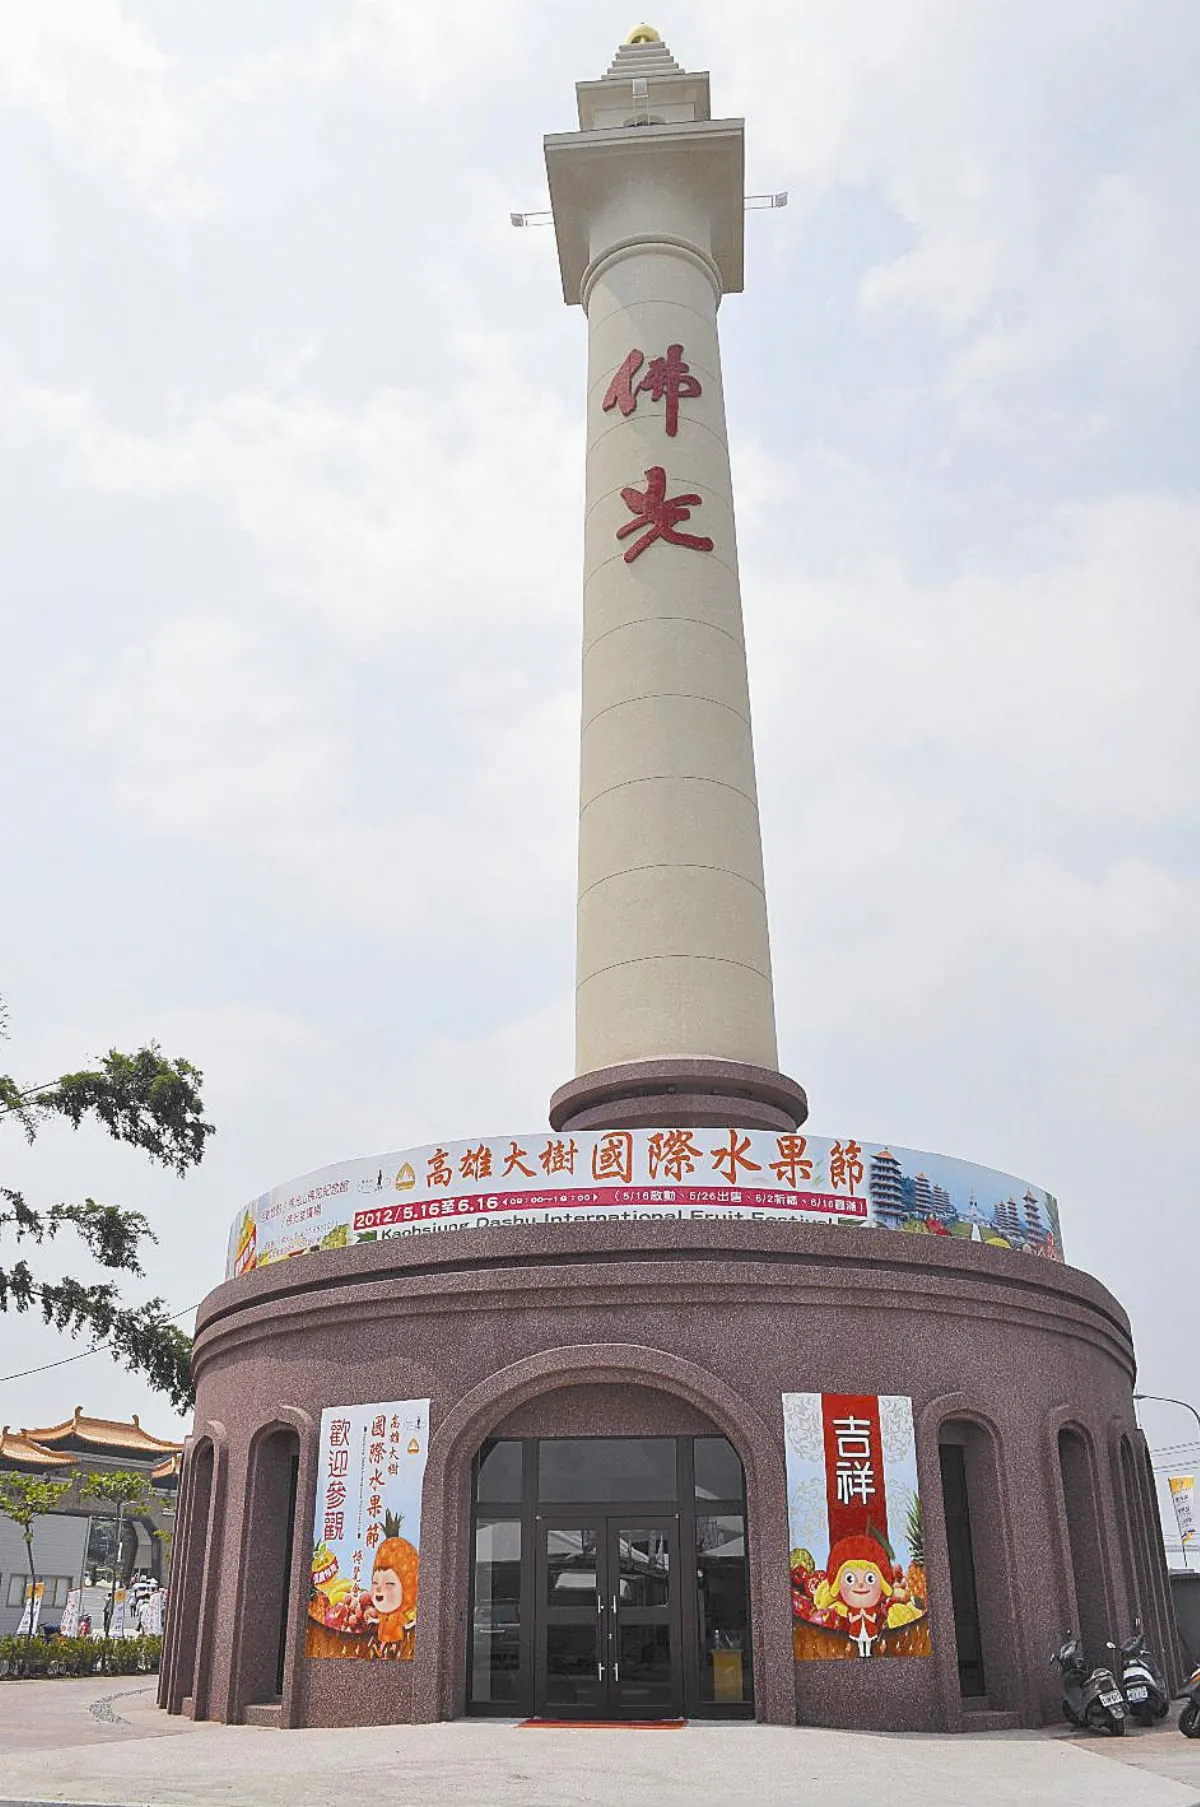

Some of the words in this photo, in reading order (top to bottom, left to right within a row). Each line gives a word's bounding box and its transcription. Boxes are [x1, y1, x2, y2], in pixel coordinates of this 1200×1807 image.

[426, 1129, 865, 1196] 高雄大樹國際水果節
[323, 1418, 351, 1541] 歡迎參觀
[366, 1413, 387, 1550] 國際水果節
[832, 1415, 876, 1505] 吉祥
